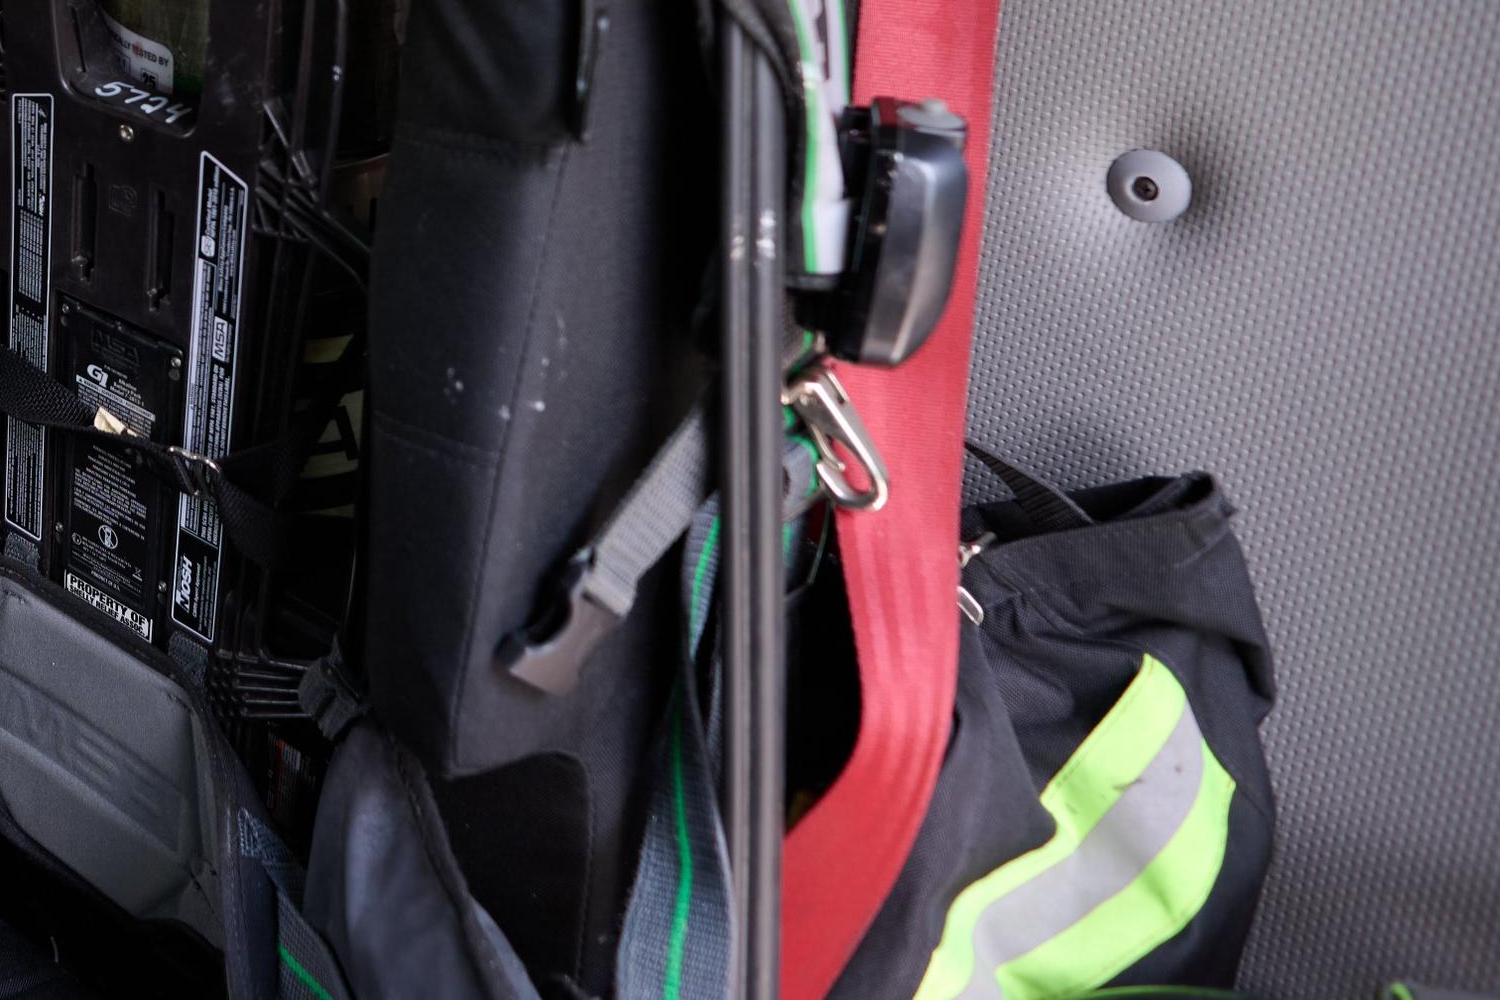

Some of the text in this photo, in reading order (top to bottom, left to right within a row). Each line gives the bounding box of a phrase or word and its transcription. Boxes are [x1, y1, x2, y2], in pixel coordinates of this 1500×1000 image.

[158, 56, 170, 68] BY
[93, 80, 193, 124] 5724
[214, 322, 225, 356] MSA
[86, 363, 110, 388] G1
[70, 575, 146, 626] PROPERTY OF
[174, 553, 192, 612] NIOSH
[69, 585, 95, 607] SHELLY
[95, 599, 119, 622] RELIEF
